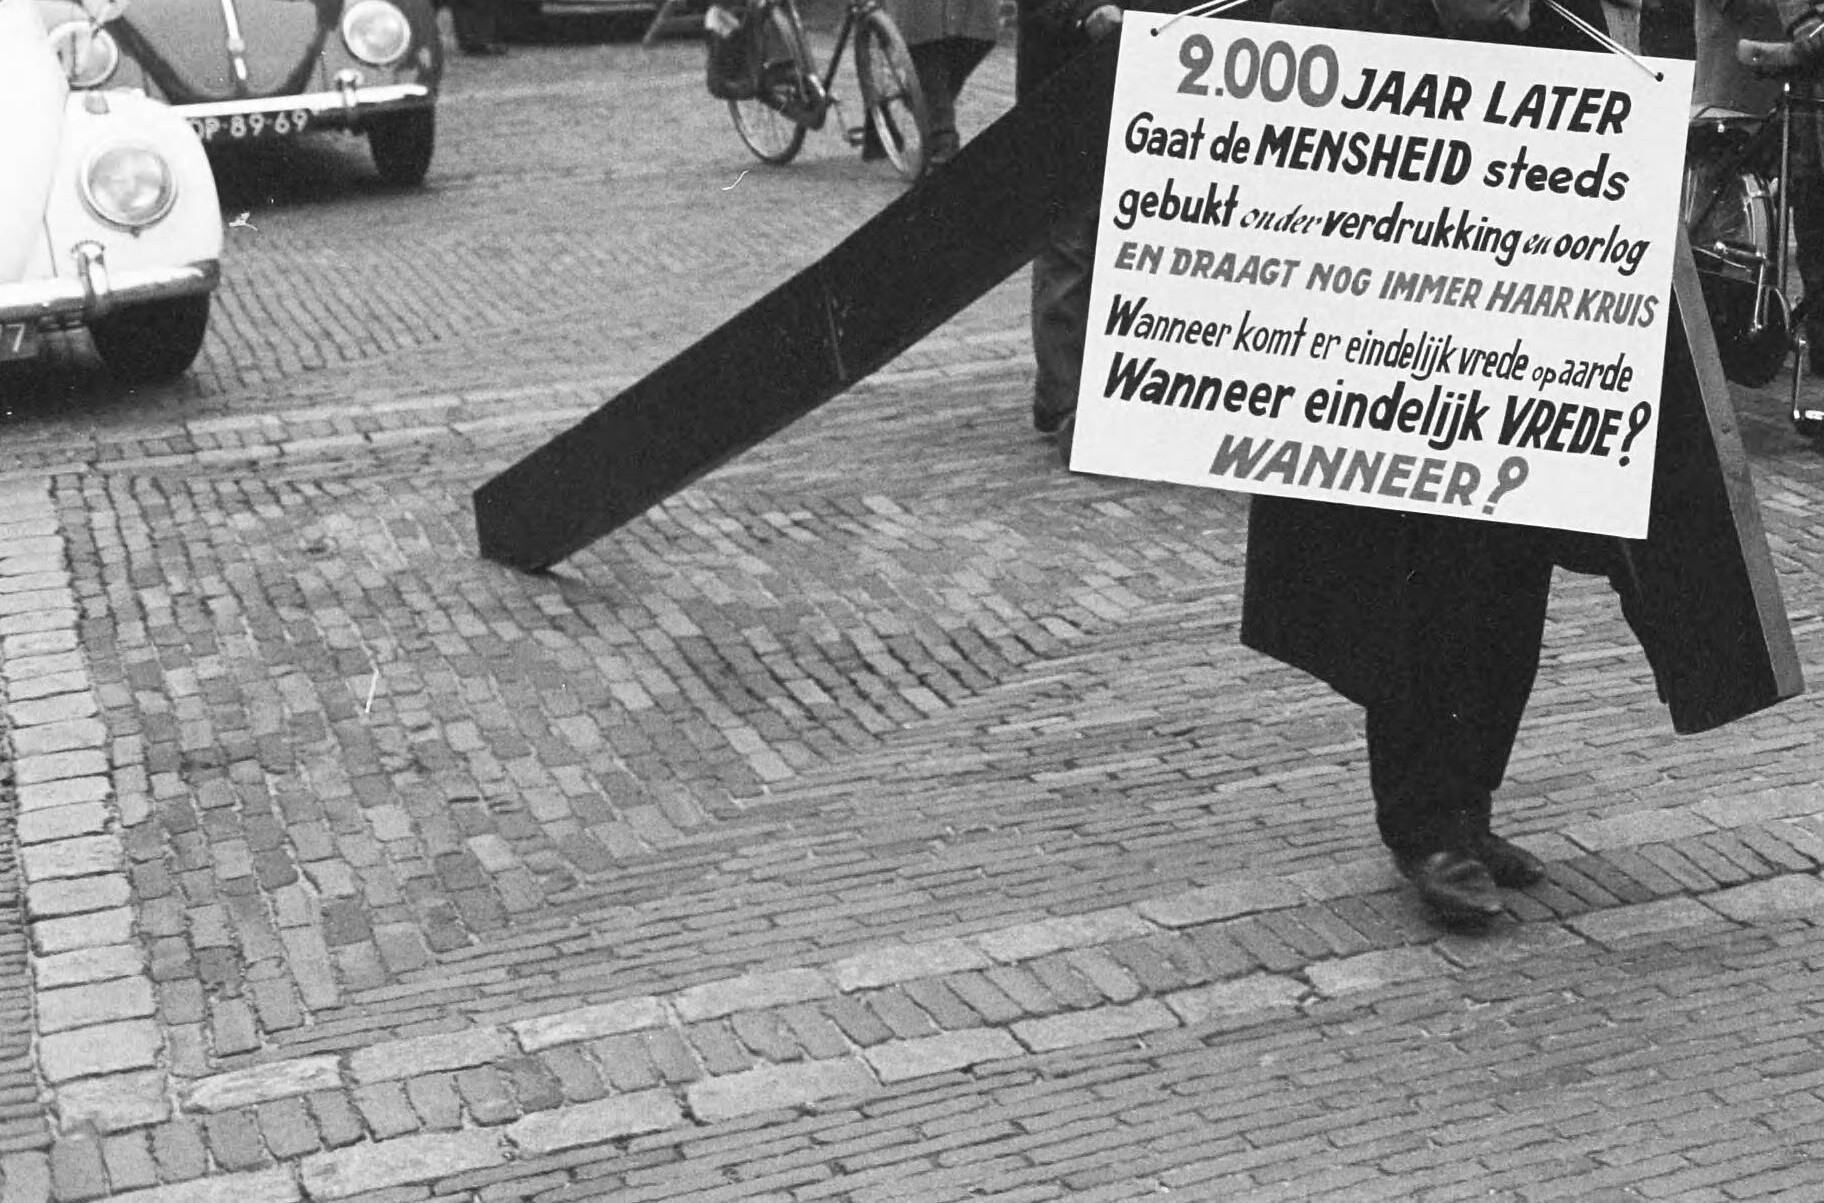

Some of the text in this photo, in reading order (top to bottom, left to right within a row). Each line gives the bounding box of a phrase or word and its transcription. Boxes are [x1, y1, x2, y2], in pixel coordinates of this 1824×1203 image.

[1177, 34, 1637, 135] 2.000 JAAR LATER
[1125, 112, 1630, 202] Gaat de MENSHEID steeds
[1113, 177, 1651, 277] gebukt onder verdrukking en oorlog
[1115, 242, 1660, 328] EN DRAAGT NOG IMMER HAAR KRUIS
[1104, 294, 1634, 393] Wanneer komt er eindelijk vrede op aarde
[1103, 352, 1652, 468] Wanneer eindelijk VREDE?
[1209, 435, 1530, 516] WANNEER?
